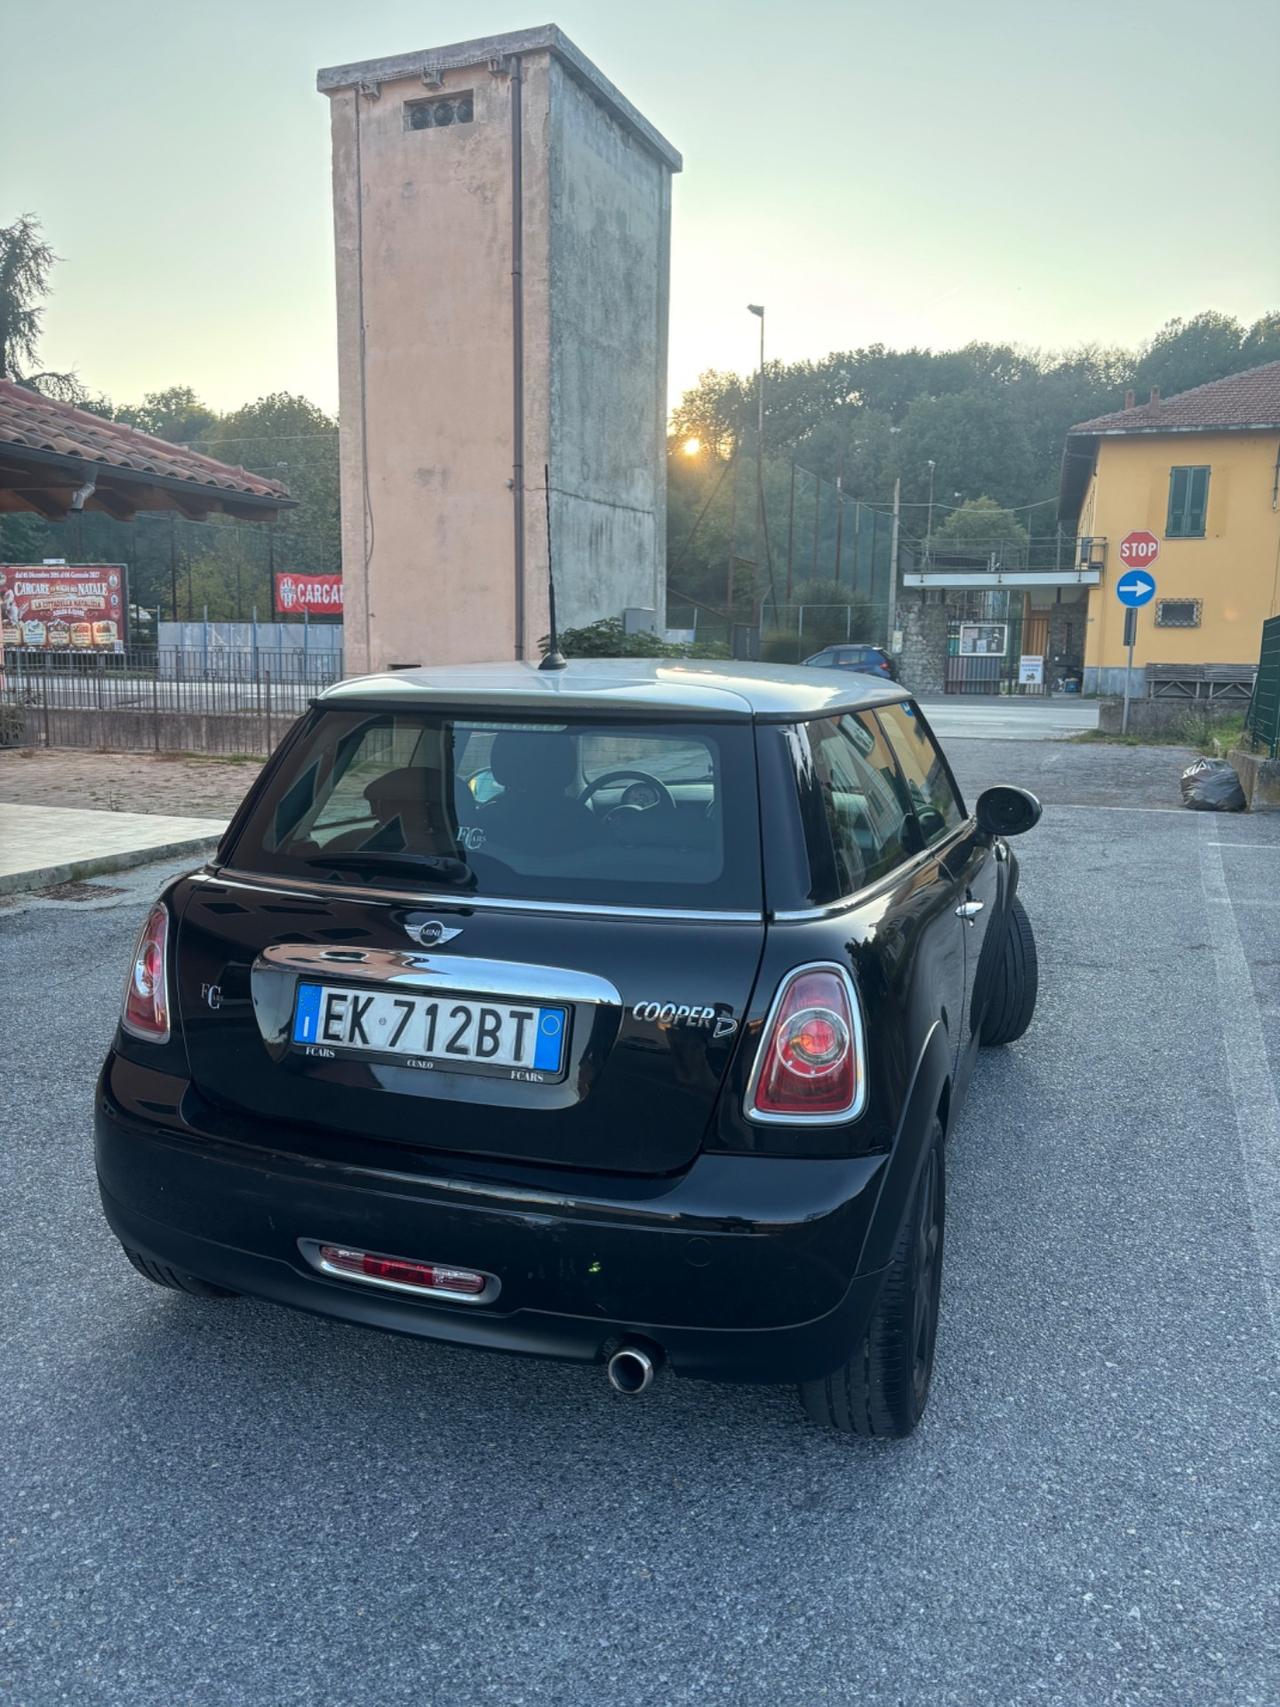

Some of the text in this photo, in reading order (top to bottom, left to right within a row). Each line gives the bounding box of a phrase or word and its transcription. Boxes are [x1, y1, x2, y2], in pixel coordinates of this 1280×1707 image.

[1121, 542, 1157, 557] STOP
[14, 582, 50, 596] CARCARE
[78, 583, 108, 596] NATALE
[422, 928, 441, 937] MINI
[632, 1000, 715, 1029] COOPER
[305, 1046, 336, 1059] FCARS
[510, 1070, 544, 1083] FCARS
